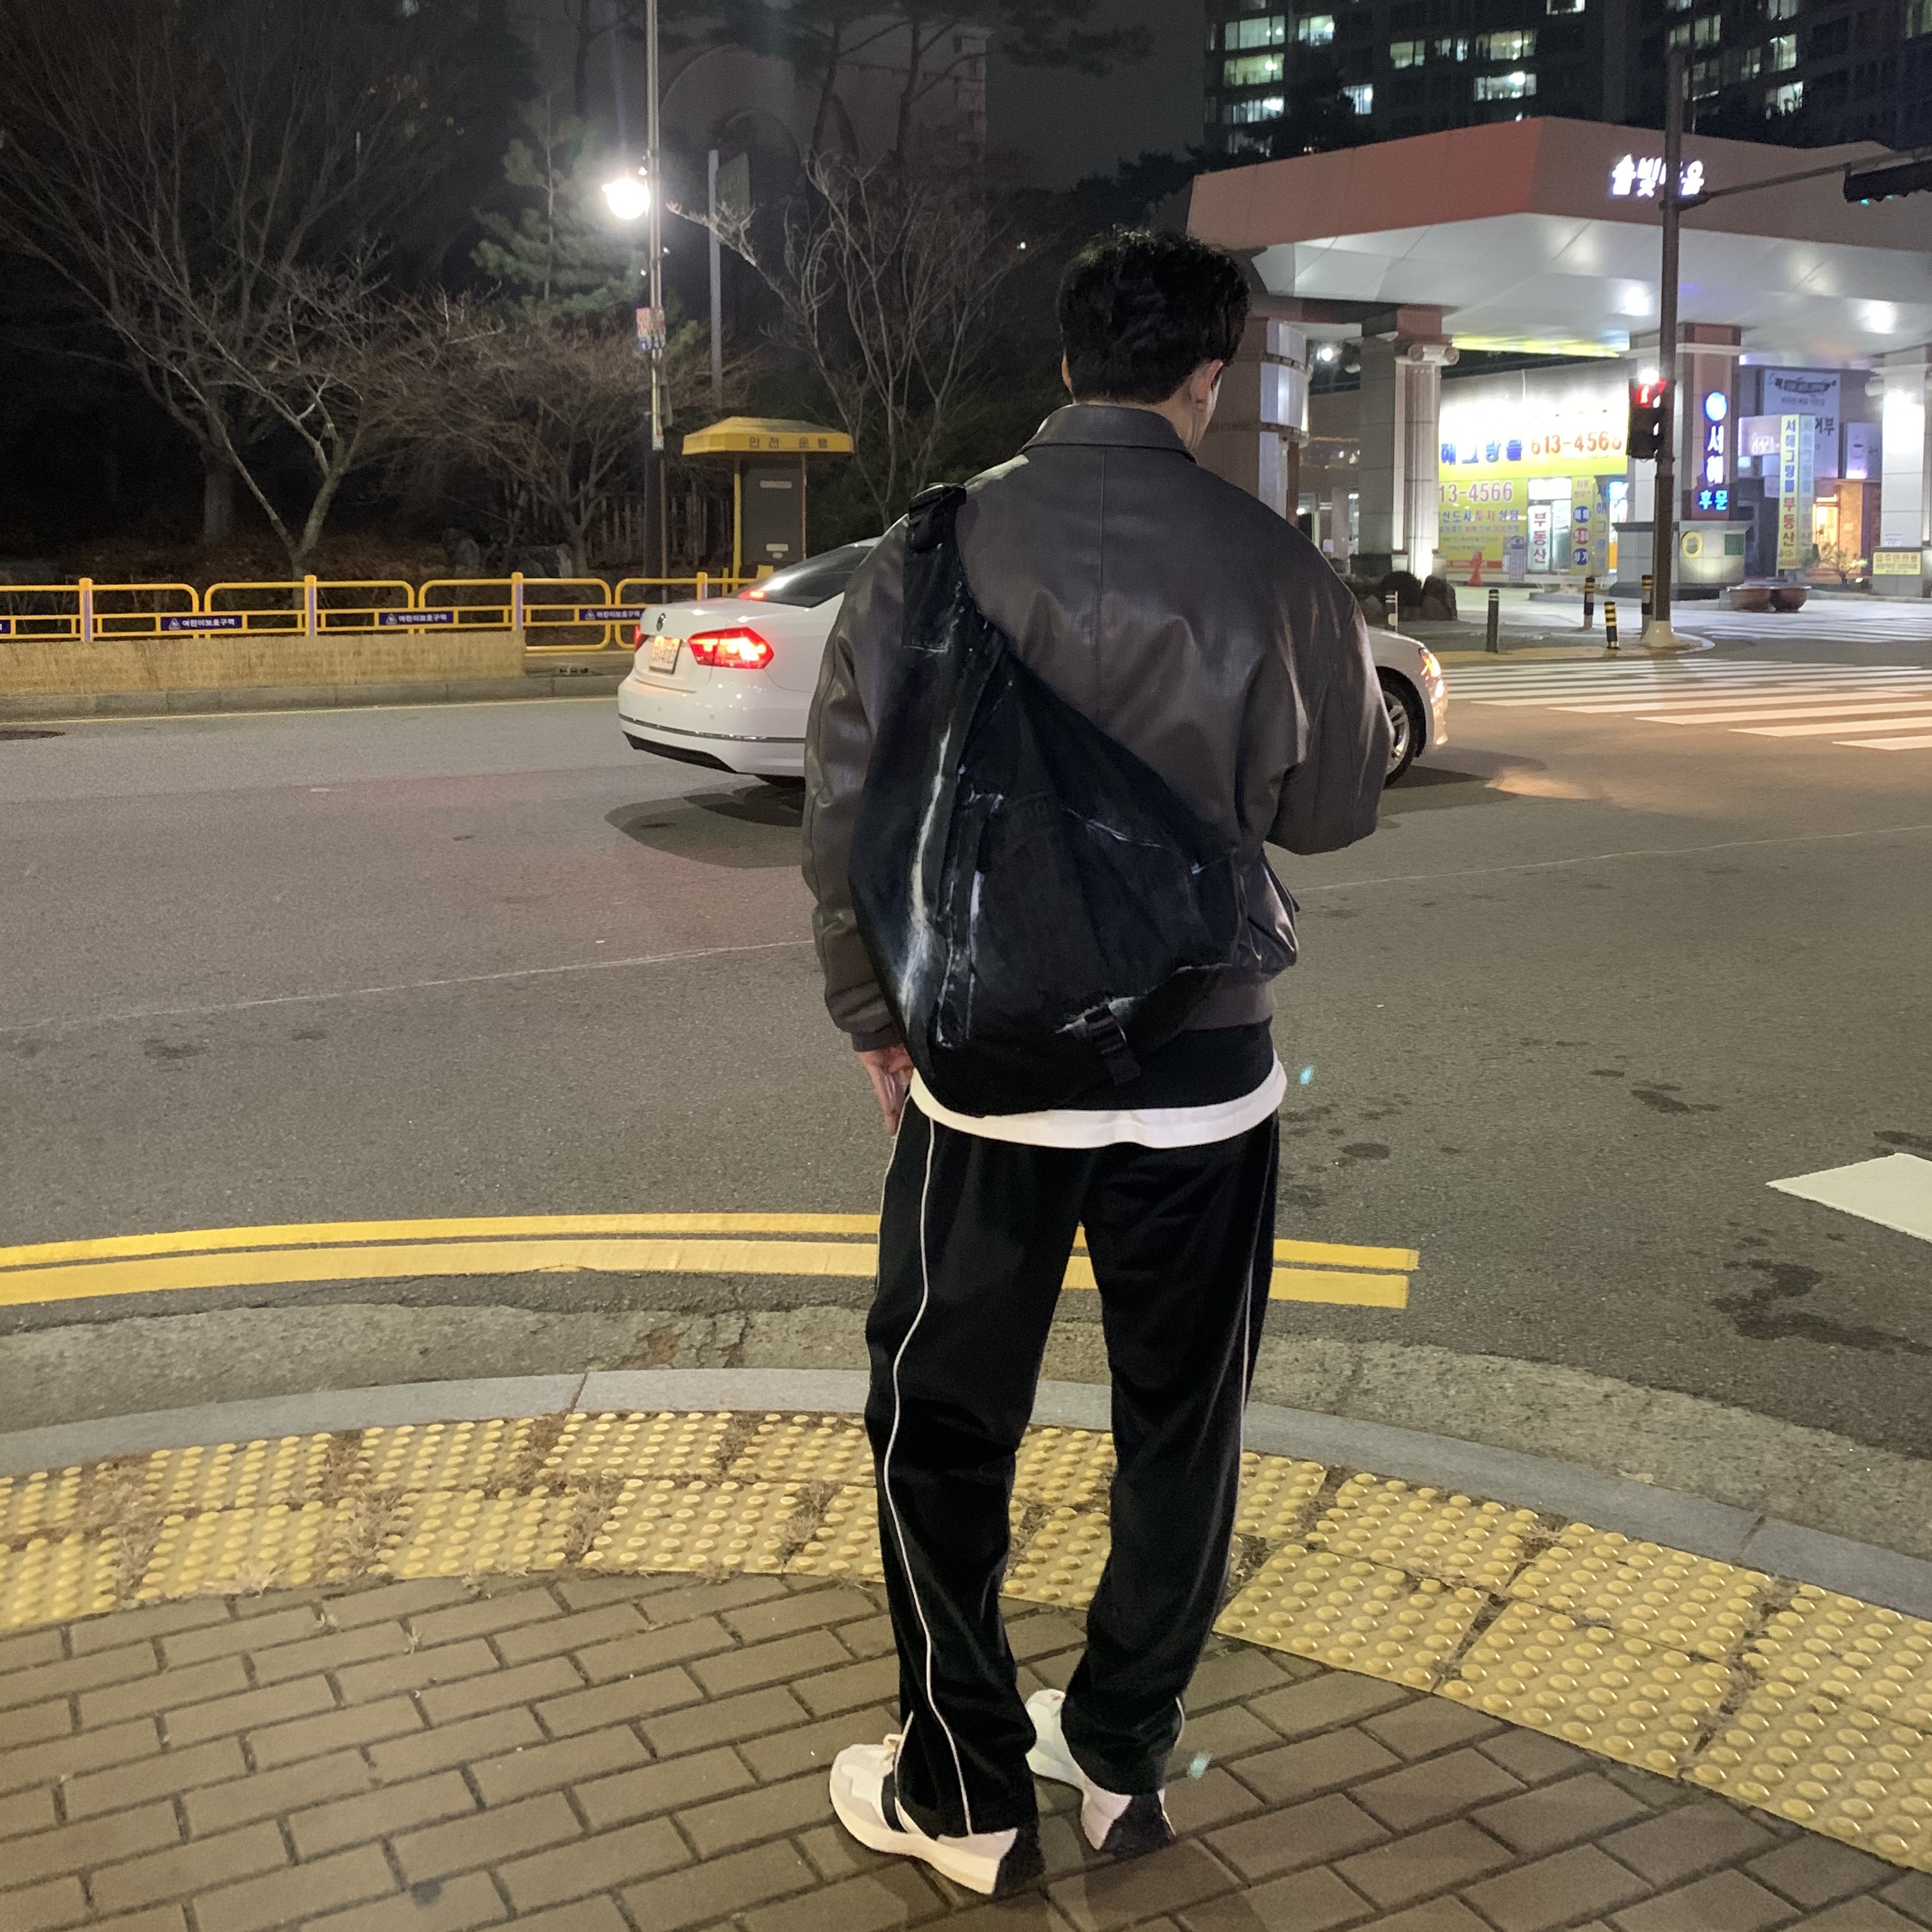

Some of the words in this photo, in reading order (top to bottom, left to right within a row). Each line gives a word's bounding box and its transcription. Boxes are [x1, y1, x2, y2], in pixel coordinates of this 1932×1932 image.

[1611, 153, 1705, 197] 솔빛을
[749, 436, 780, 448] 안전
[1699, 490, 1728, 510] 후문
[1782, 497, 1796, 547] 부동산
[1533, 512, 1547, 564] 부동산
